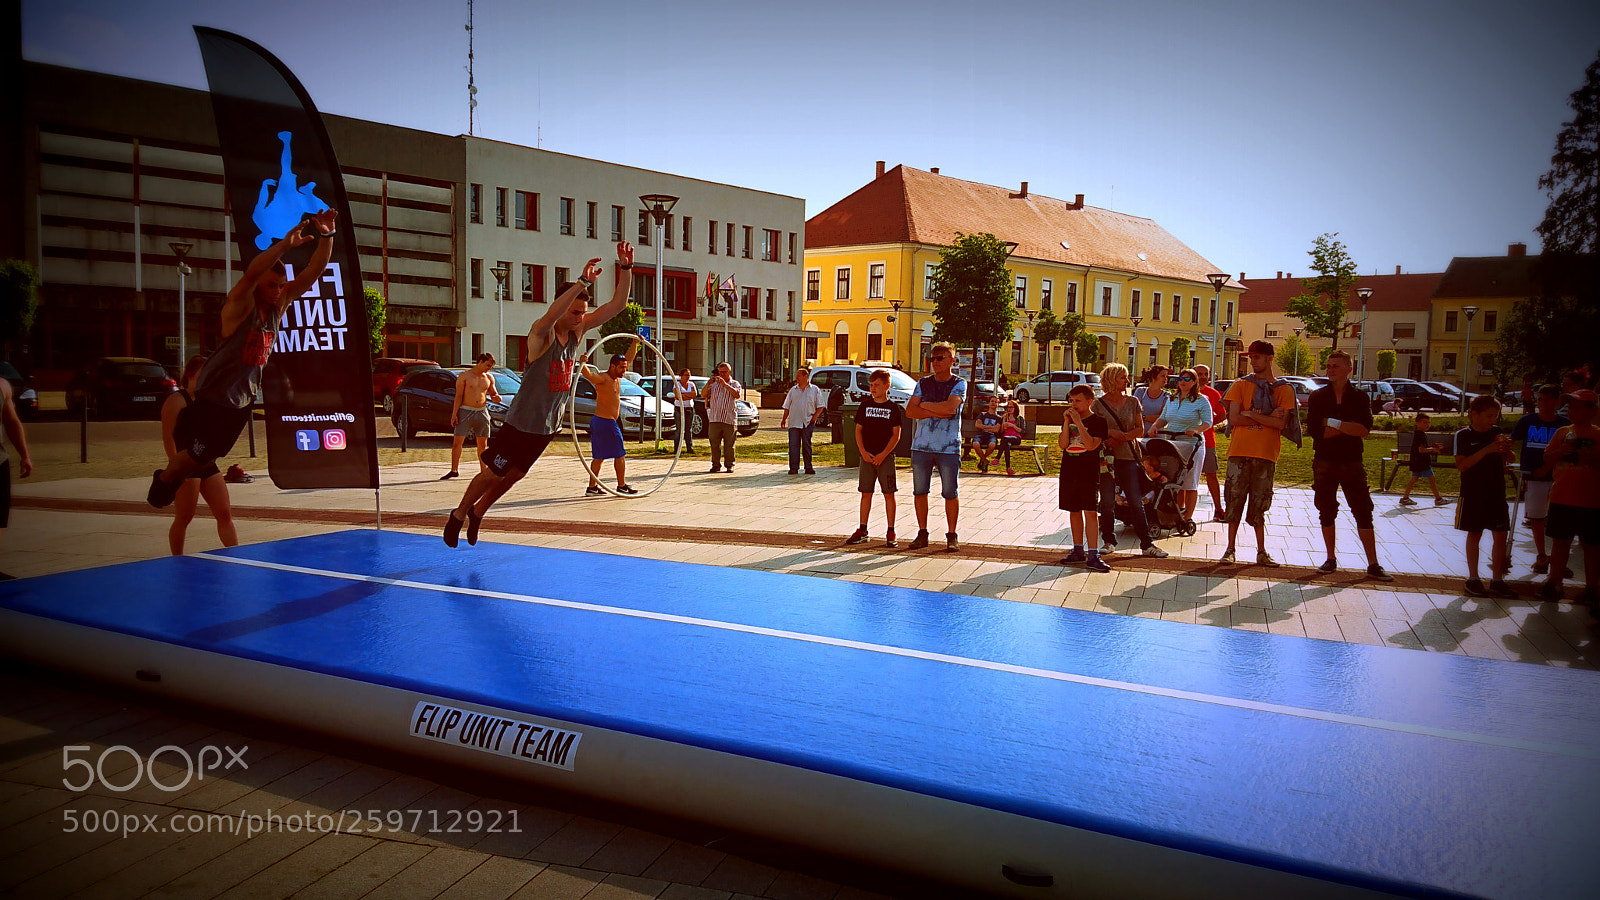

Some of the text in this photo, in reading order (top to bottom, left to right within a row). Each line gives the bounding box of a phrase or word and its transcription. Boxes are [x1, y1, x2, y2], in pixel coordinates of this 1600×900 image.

[550, 360, 574, 374] FLIP
[549, 373, 571, 385] UNIT
[548, 383, 570, 393] TEAM
[414, 704, 577, 766] FLIP UNIT TEAM
